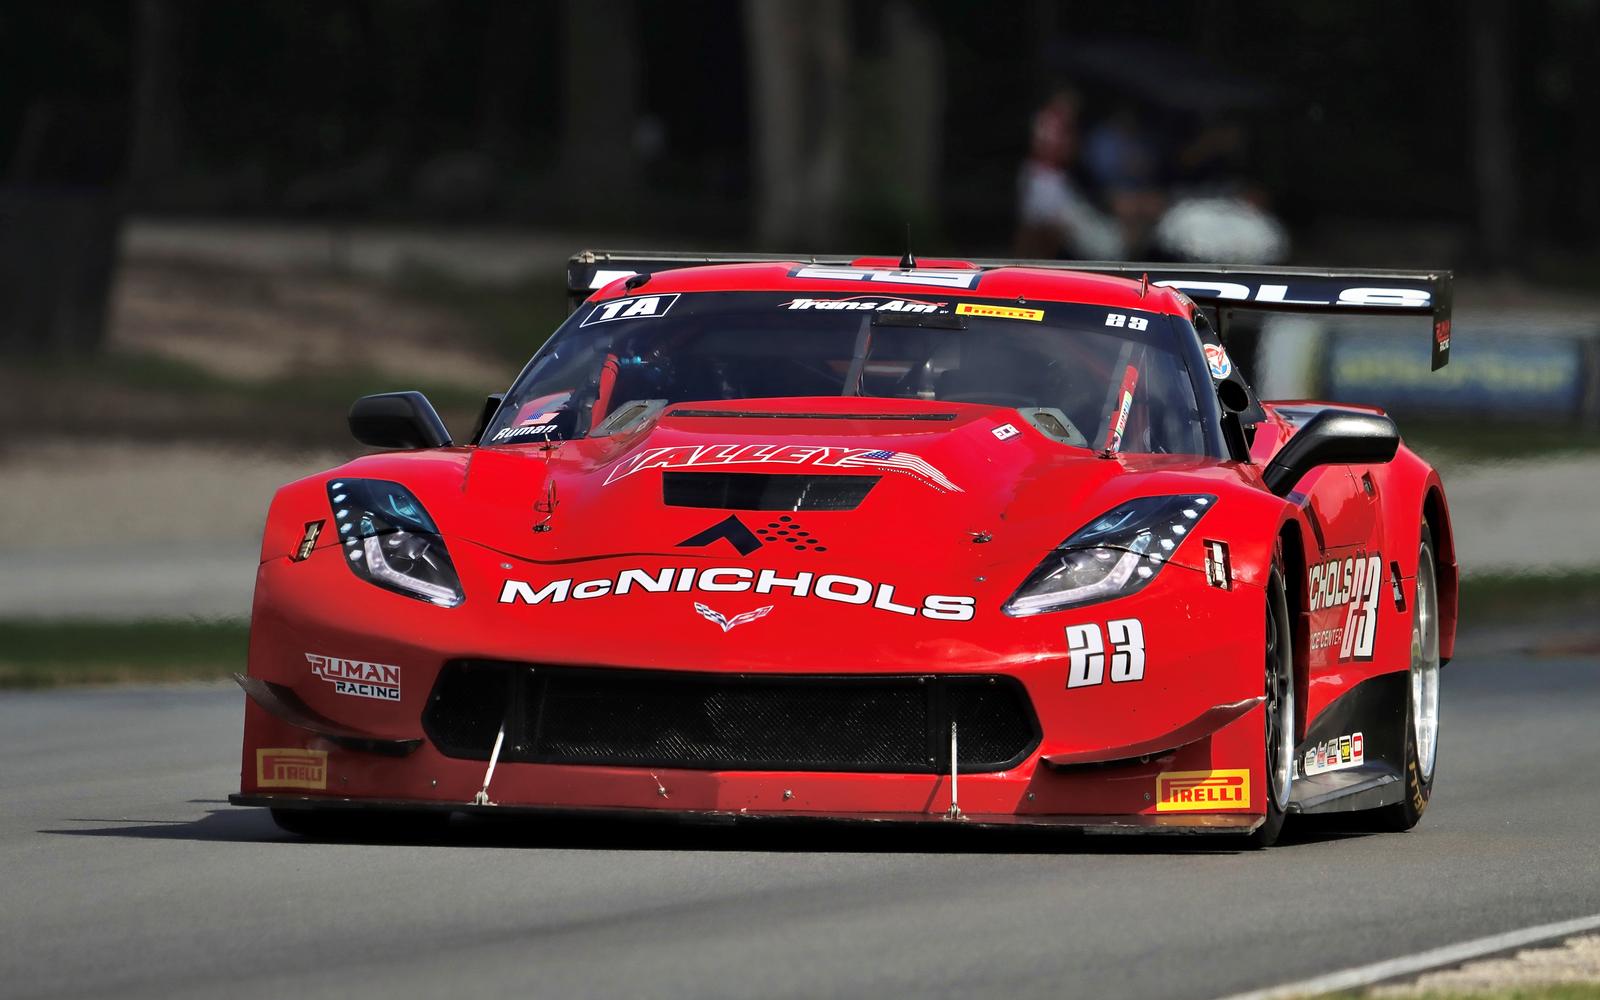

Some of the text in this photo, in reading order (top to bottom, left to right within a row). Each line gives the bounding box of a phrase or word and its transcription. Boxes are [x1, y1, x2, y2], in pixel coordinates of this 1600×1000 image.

[600, 297, 661, 321] TA
[787, 298, 878, 311] Trans
[875, 300, 939, 314] Am
[962, 304, 1037, 319] PIRELLI
[602, 444, 866, 486] VALLEY
[497, 566, 977, 622] McNICHOLS
[1338, 555, 1382, 662] 23
[1064, 617, 1147, 689] 23
[306, 654, 400, 685] RUMAN
[336, 681, 400, 699] RACING
[262, 755, 324, 781] PIRELLI
[1160, 776, 1244, 803] PIRELLI
